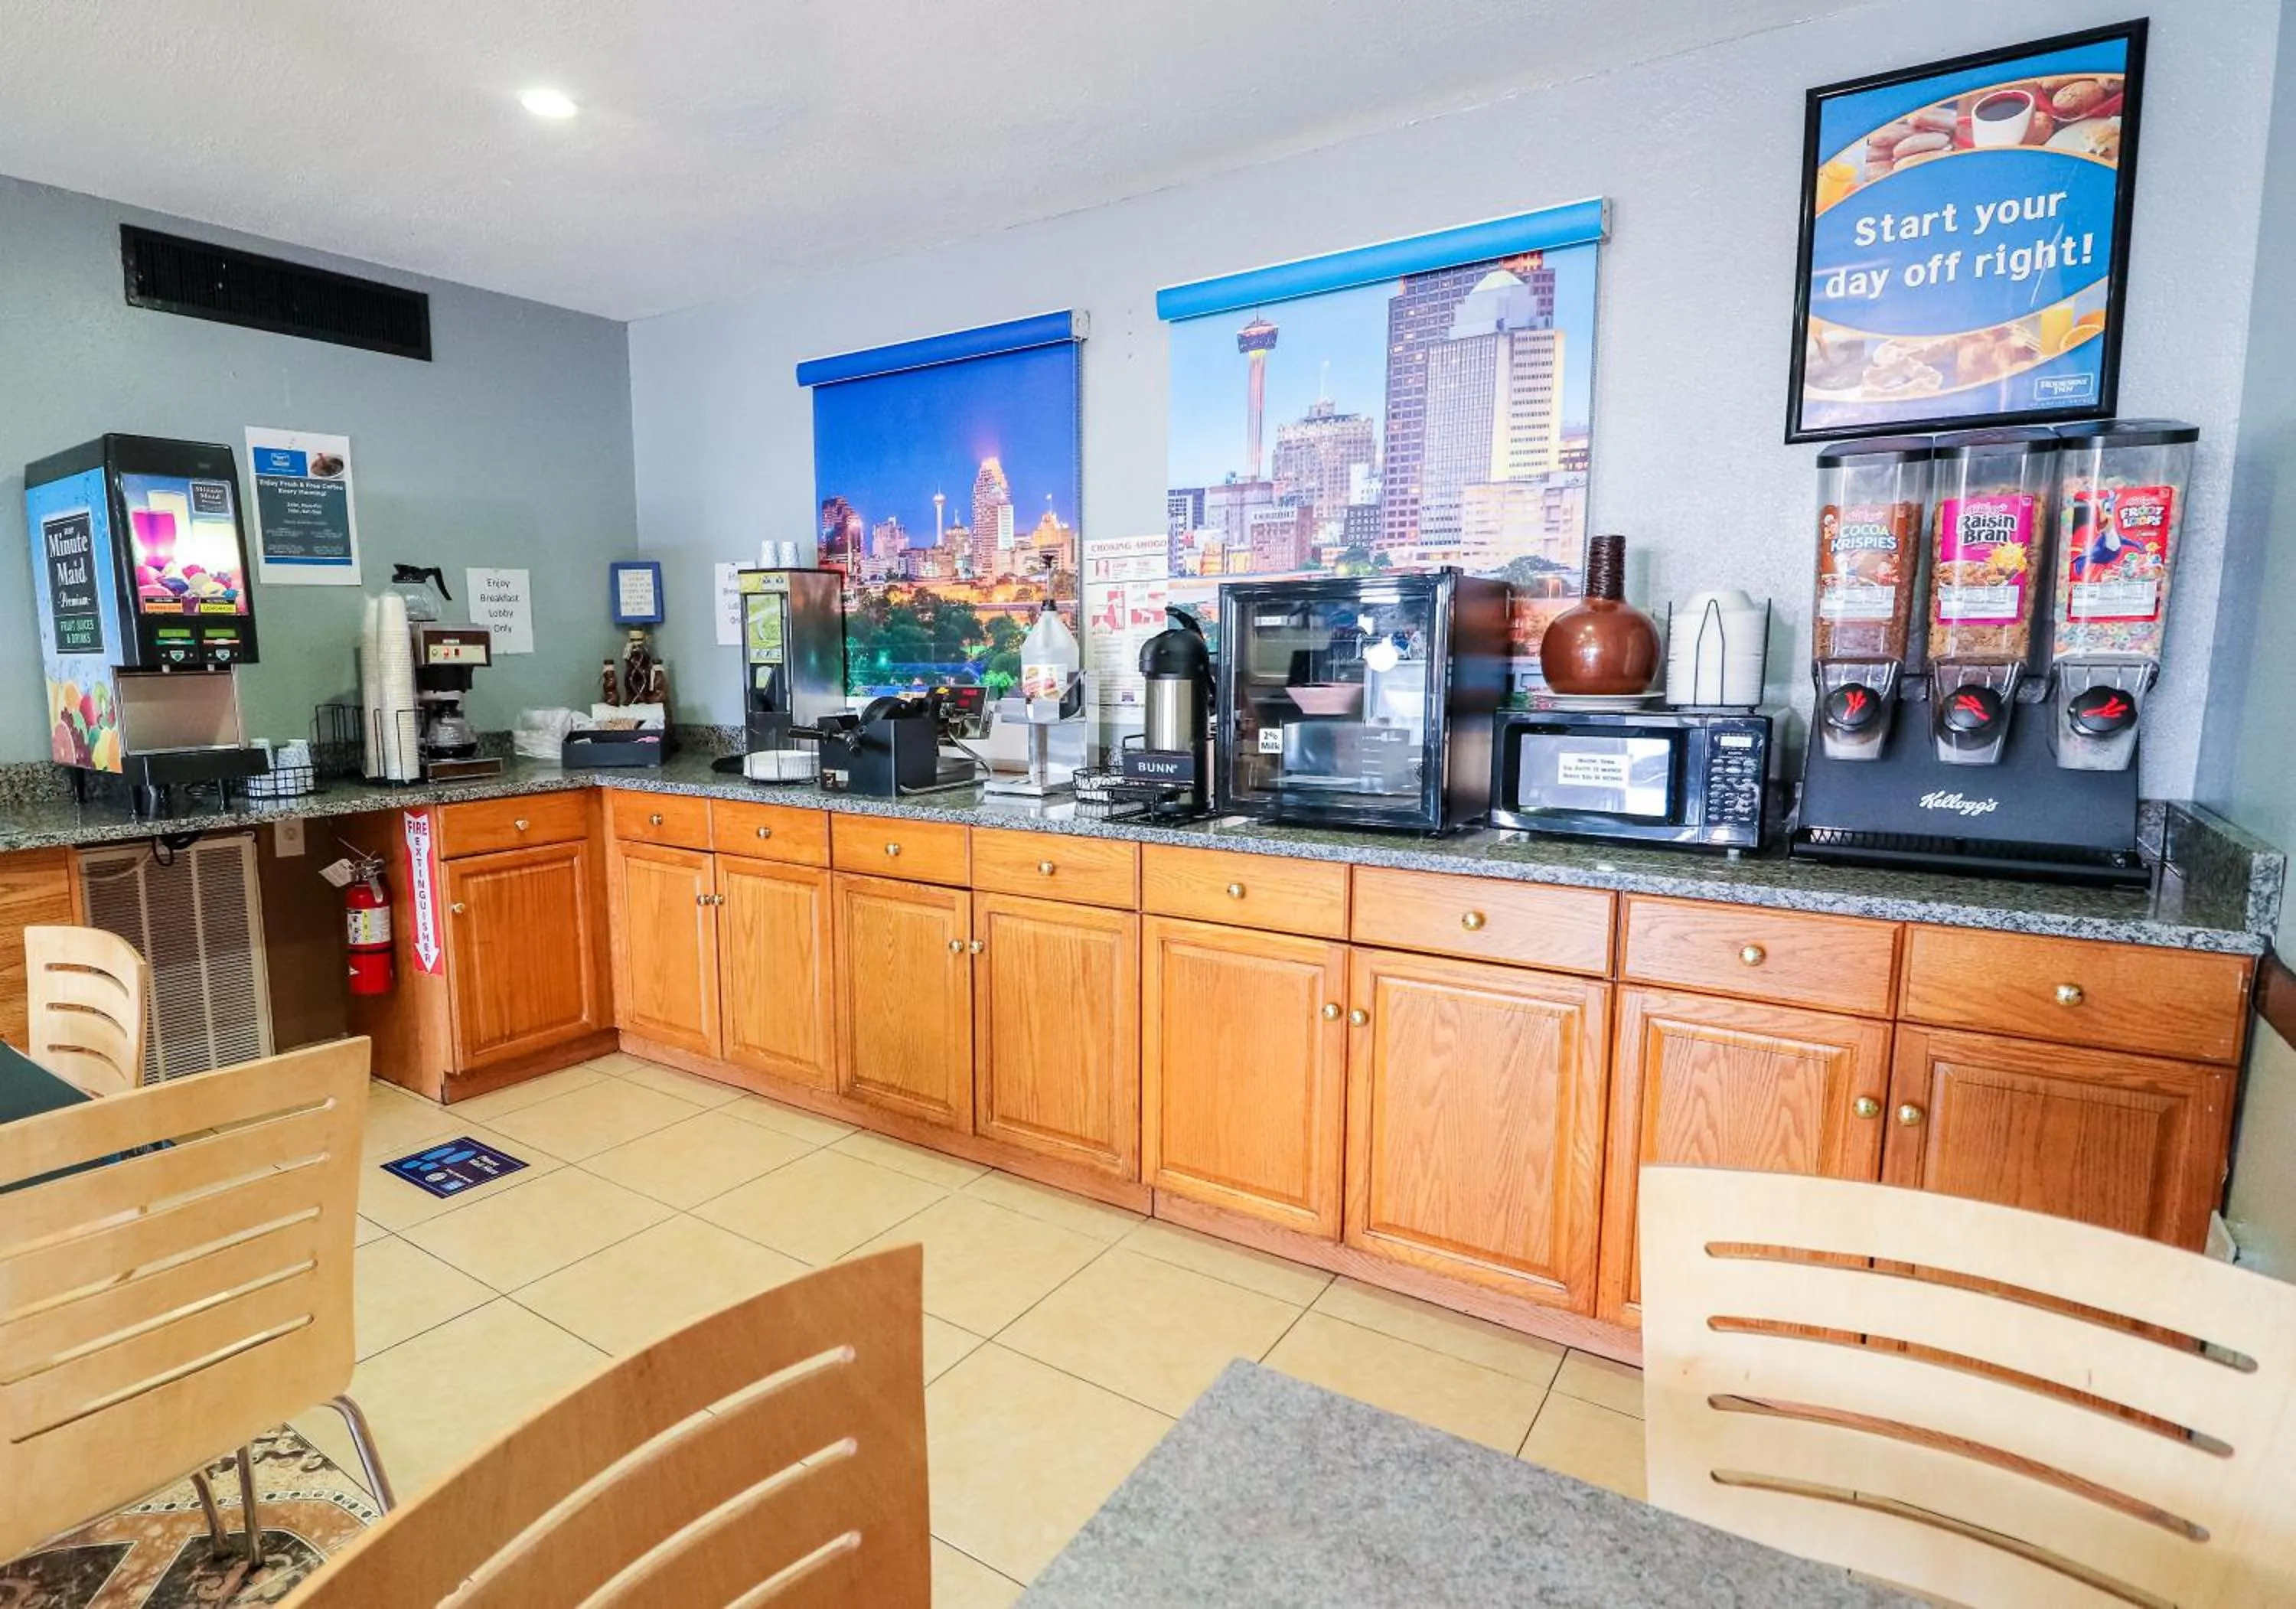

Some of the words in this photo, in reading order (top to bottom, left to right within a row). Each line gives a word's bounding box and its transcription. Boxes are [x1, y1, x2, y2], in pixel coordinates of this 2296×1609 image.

[1854, 204, 1958, 246] Start
[1973, 191, 2066, 234] your
[1825, 269, 1890, 299] day
[1905, 251, 1961, 287] off
[1975, 233, 2093, 281] right!
[2119, 505, 2164, 520] FROOT
[1958, 514, 2016, 530] Raisin
[2122, 516, 2162, 529] LOOPS
[1839, 524, 1890, 538] COCOA
[1963, 528, 2008, 544] Bran
[48, 532, 89, 558] Minute
[1830, 536, 1898, 553] KRISPIES
[57, 557, 88, 586] Maid
[487, 578, 510, 589] Enjoy
[480, 593, 520, 602] Breakfast
[488, 609, 514, 618] Lobby
[494, 624, 512, 634] Only
[1264, 730, 1279, 740] 2%
[1261, 740, 1281, 751] Milk
[1137, 761, 1176, 775] BUNN
[1919, 790, 1999, 817] Kellogg's
[407, 820, 428, 837] FIRE
